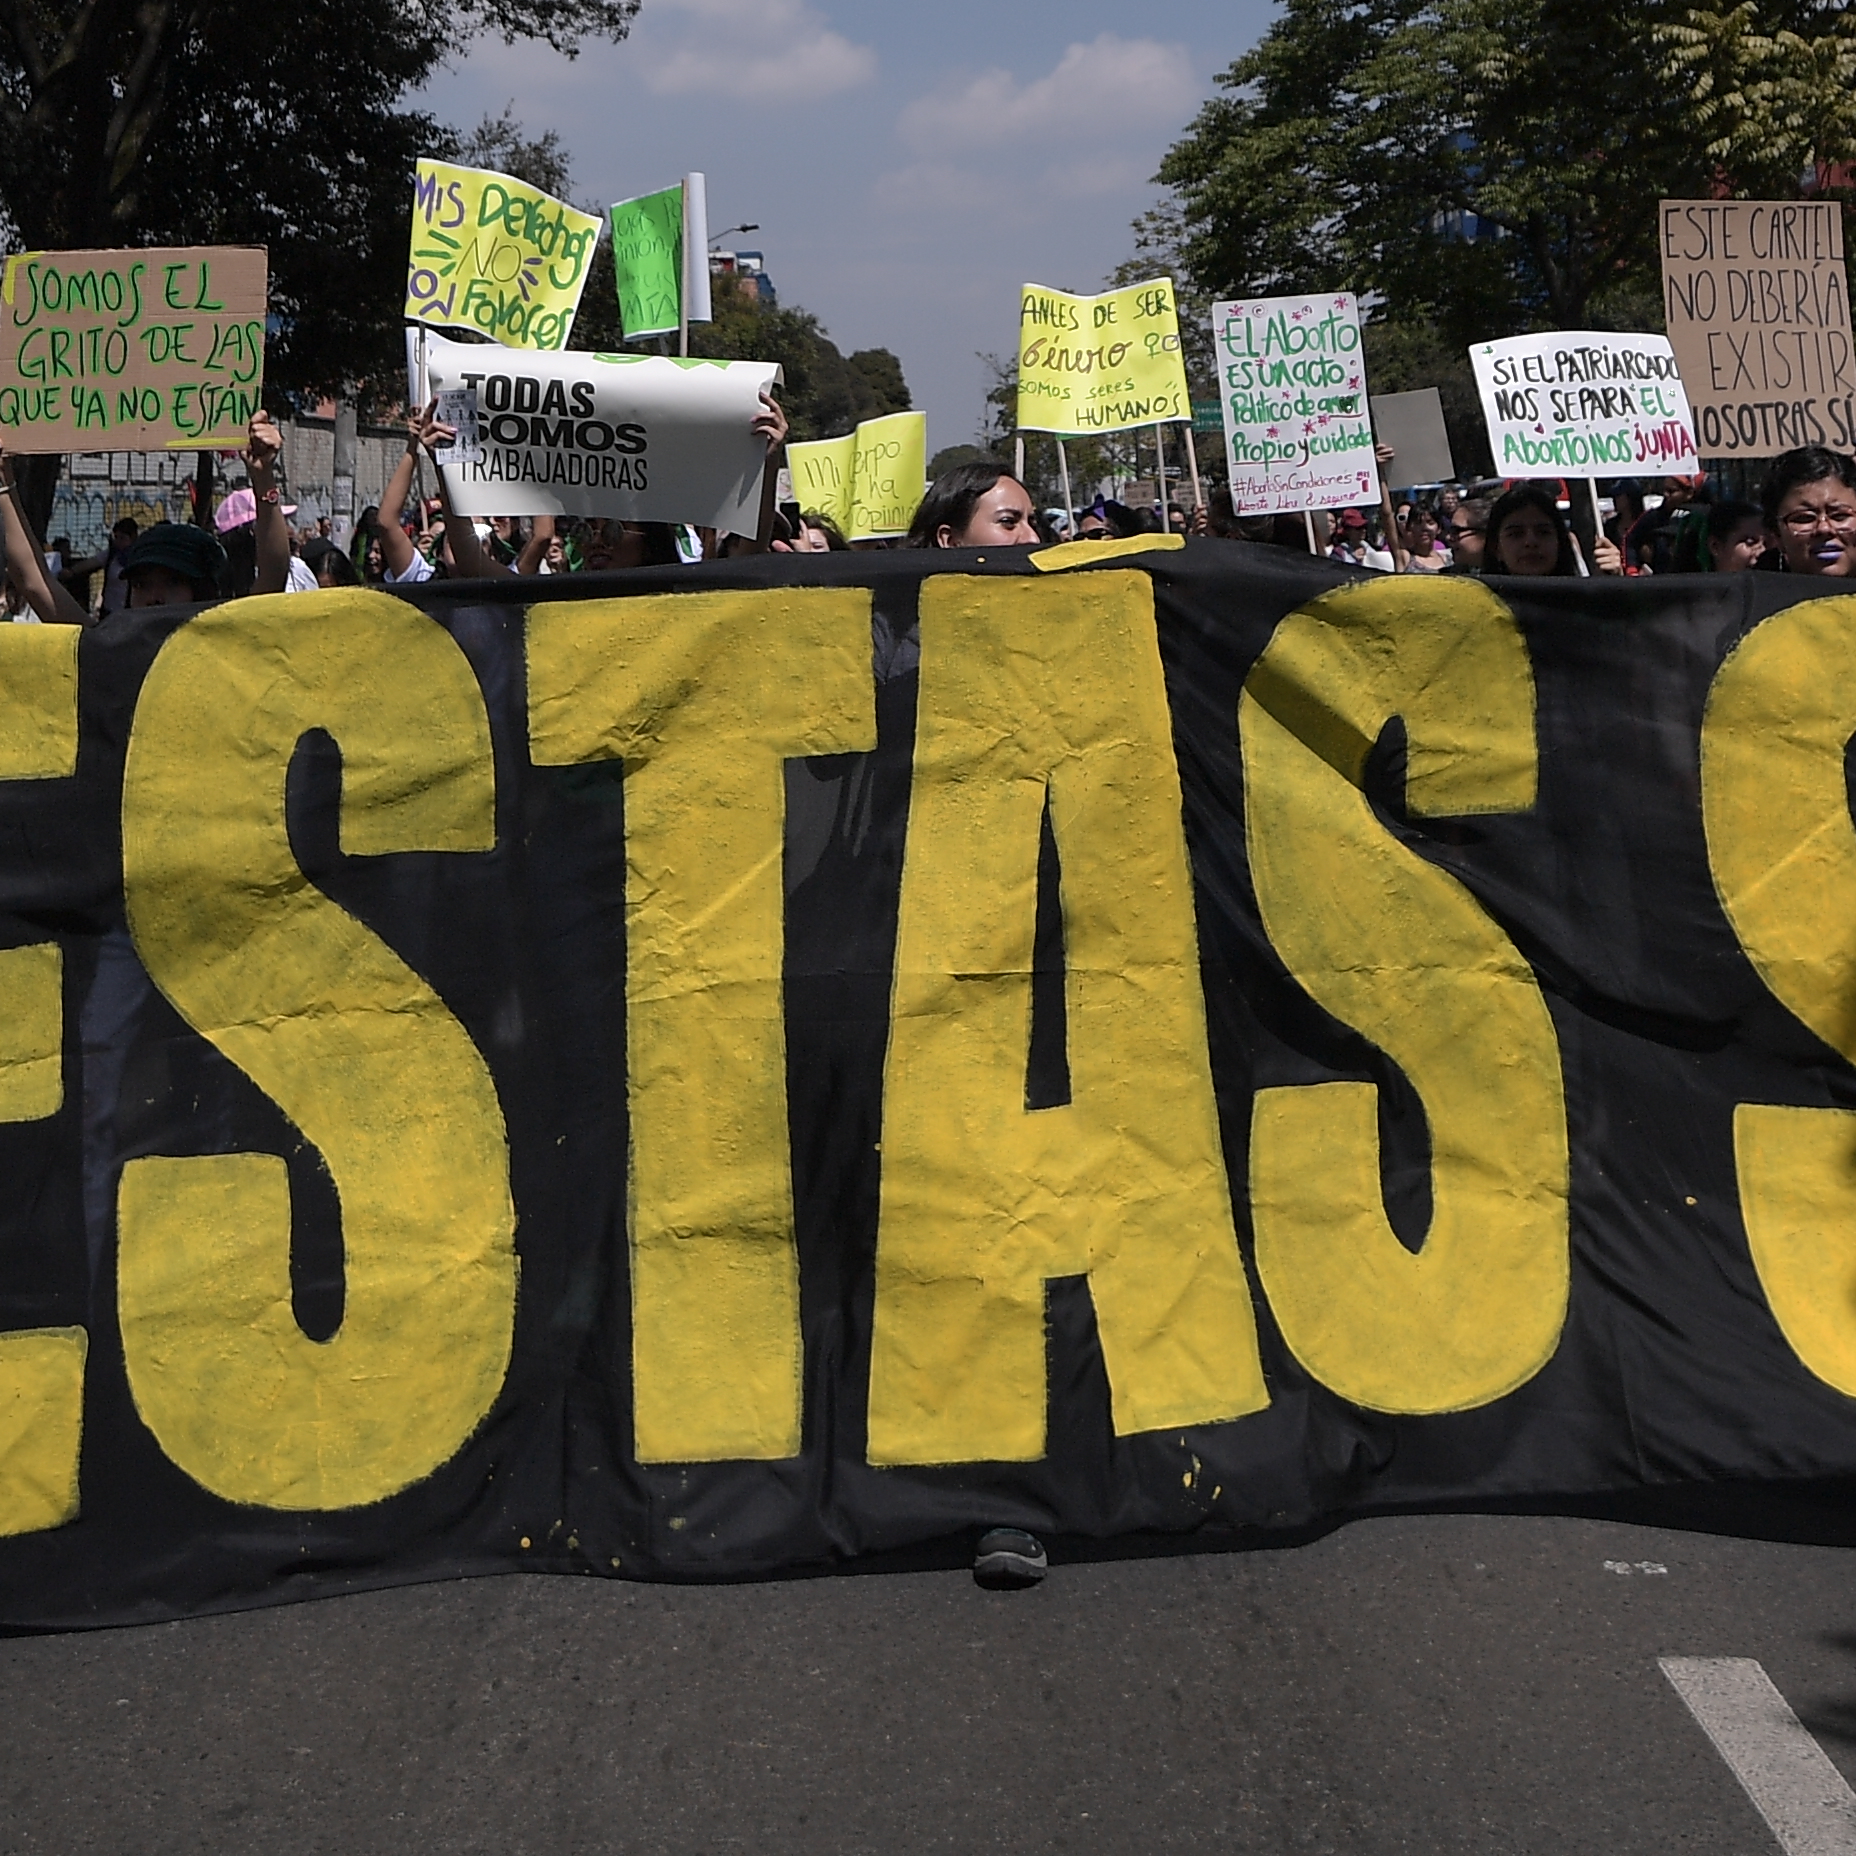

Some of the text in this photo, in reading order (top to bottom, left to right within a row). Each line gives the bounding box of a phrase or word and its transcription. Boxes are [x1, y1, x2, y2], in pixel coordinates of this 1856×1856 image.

[416, 171, 465, 228] MIS
[1664, 205, 1845, 261] ESTE CARTEL
[455, 236, 522, 283] NO
[13, 261, 225, 328] SOMOS EL
[461, 279, 574, 350] Favores
[1094, 301, 1118, 328] DE
[1133, 288, 1172, 320] SER
[1668, 261, 1845, 329] NO DEBERÍA
[17, 320, 264, 384] GRITO DE LAS
[1523, 354, 1556, 383] EL
[1707, 330, 1856, 394] EXISTIR
[460, 373, 596, 419] TODAS
[1226, 361, 1254, 390] ES
[70, 385, 110, 429] YA
[119, 385, 165, 423] NO
[171, 381, 260, 438] ESTÁN
[1076, 392, 1181, 427] HUMANOS
[1295, 389, 1315, 418] de
[1494, 386, 1675, 423] NOS SEPARA EL
[477, 413, 648, 454] SOMOS
[1232, 431, 1295, 473] Propio
[1296, 438, 1310, 468] y
[1588, 428, 1633, 465] NOS
